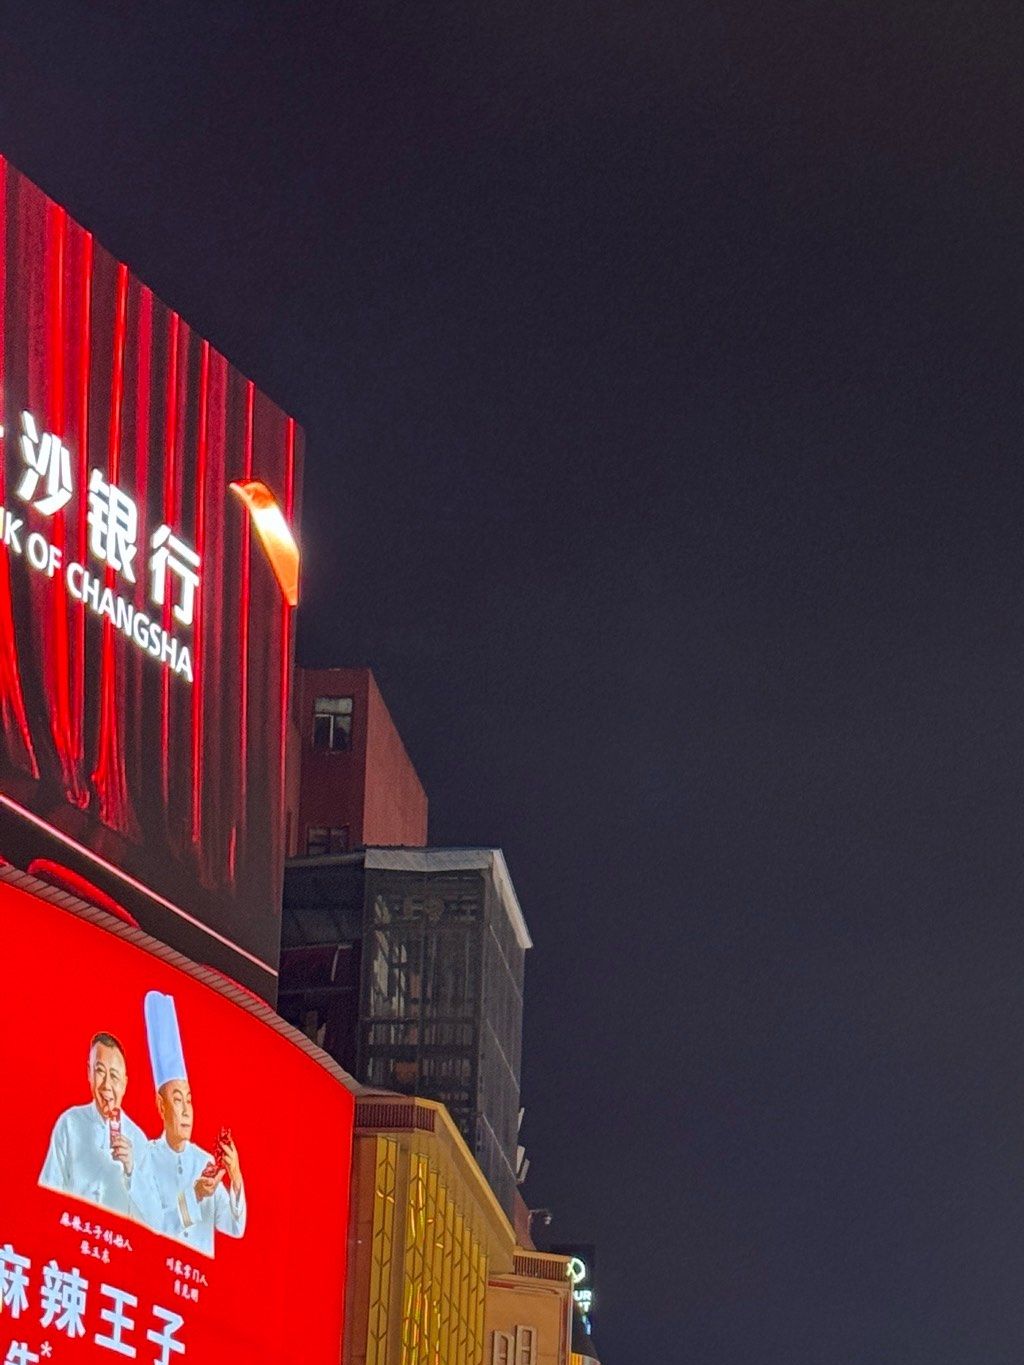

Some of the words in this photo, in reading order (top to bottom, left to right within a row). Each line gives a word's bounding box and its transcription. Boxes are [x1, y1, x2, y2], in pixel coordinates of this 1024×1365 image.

[0, 410, 201, 626] 沙银行
[27, 532, 63, 578] OF
[66, 562, 194, 683] CHANGSHA
